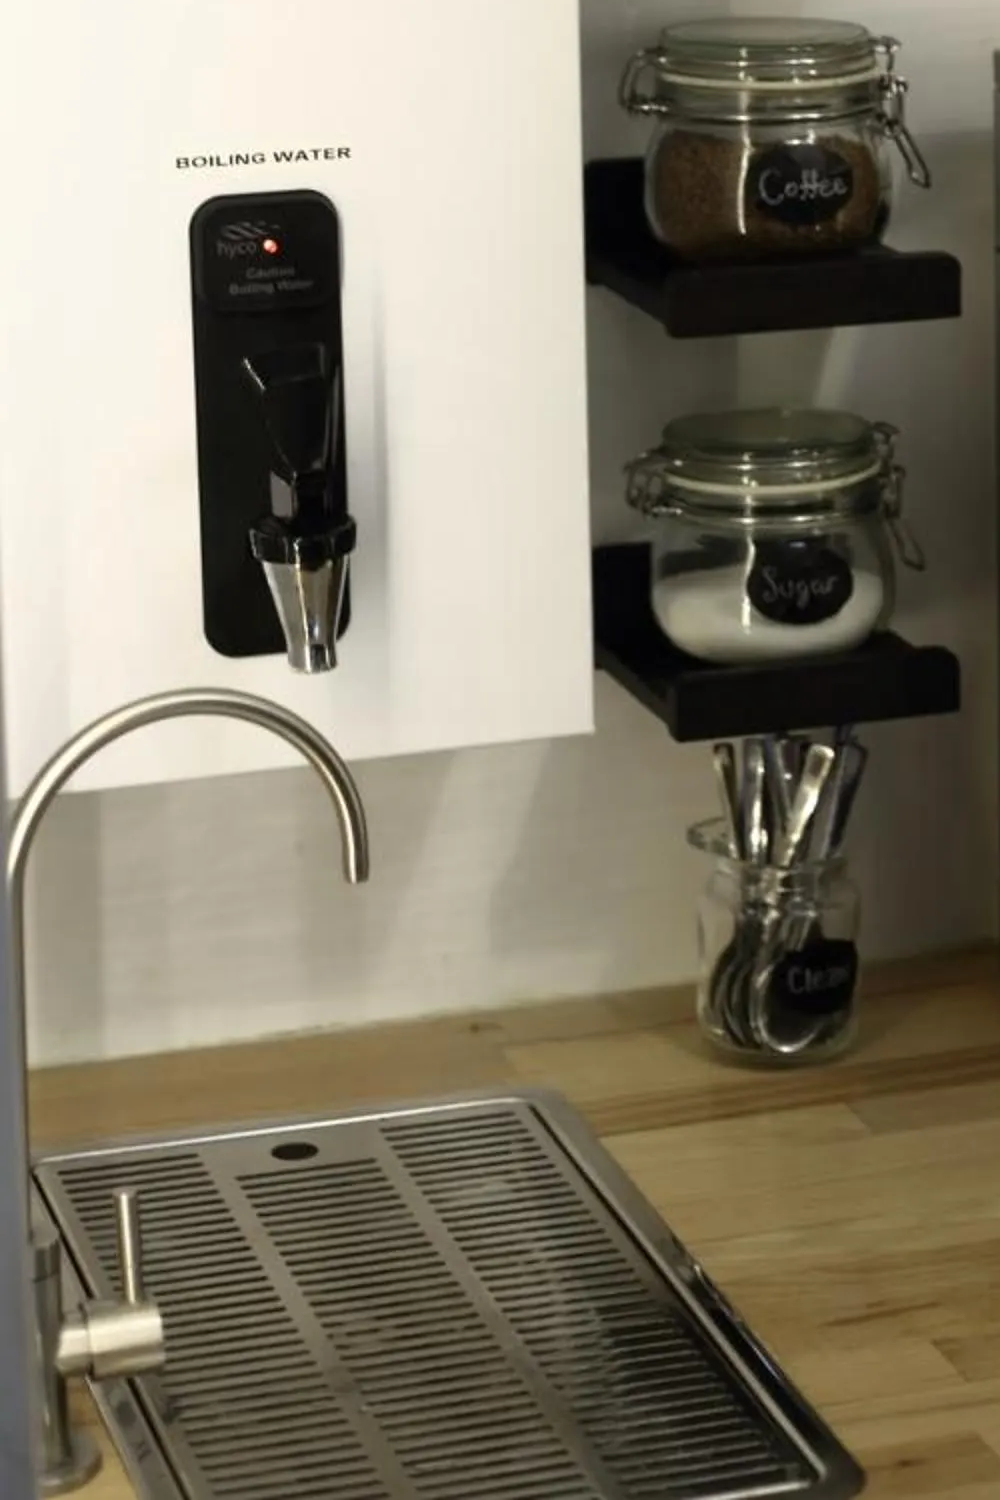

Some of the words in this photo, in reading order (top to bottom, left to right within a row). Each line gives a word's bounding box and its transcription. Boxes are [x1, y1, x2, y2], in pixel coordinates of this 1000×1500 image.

[175, 152, 266, 169] BOILING
[273, 147, 352, 163] WATER
[759, 166, 848, 206] Coffee
[761, 565, 838, 610] Sugar
